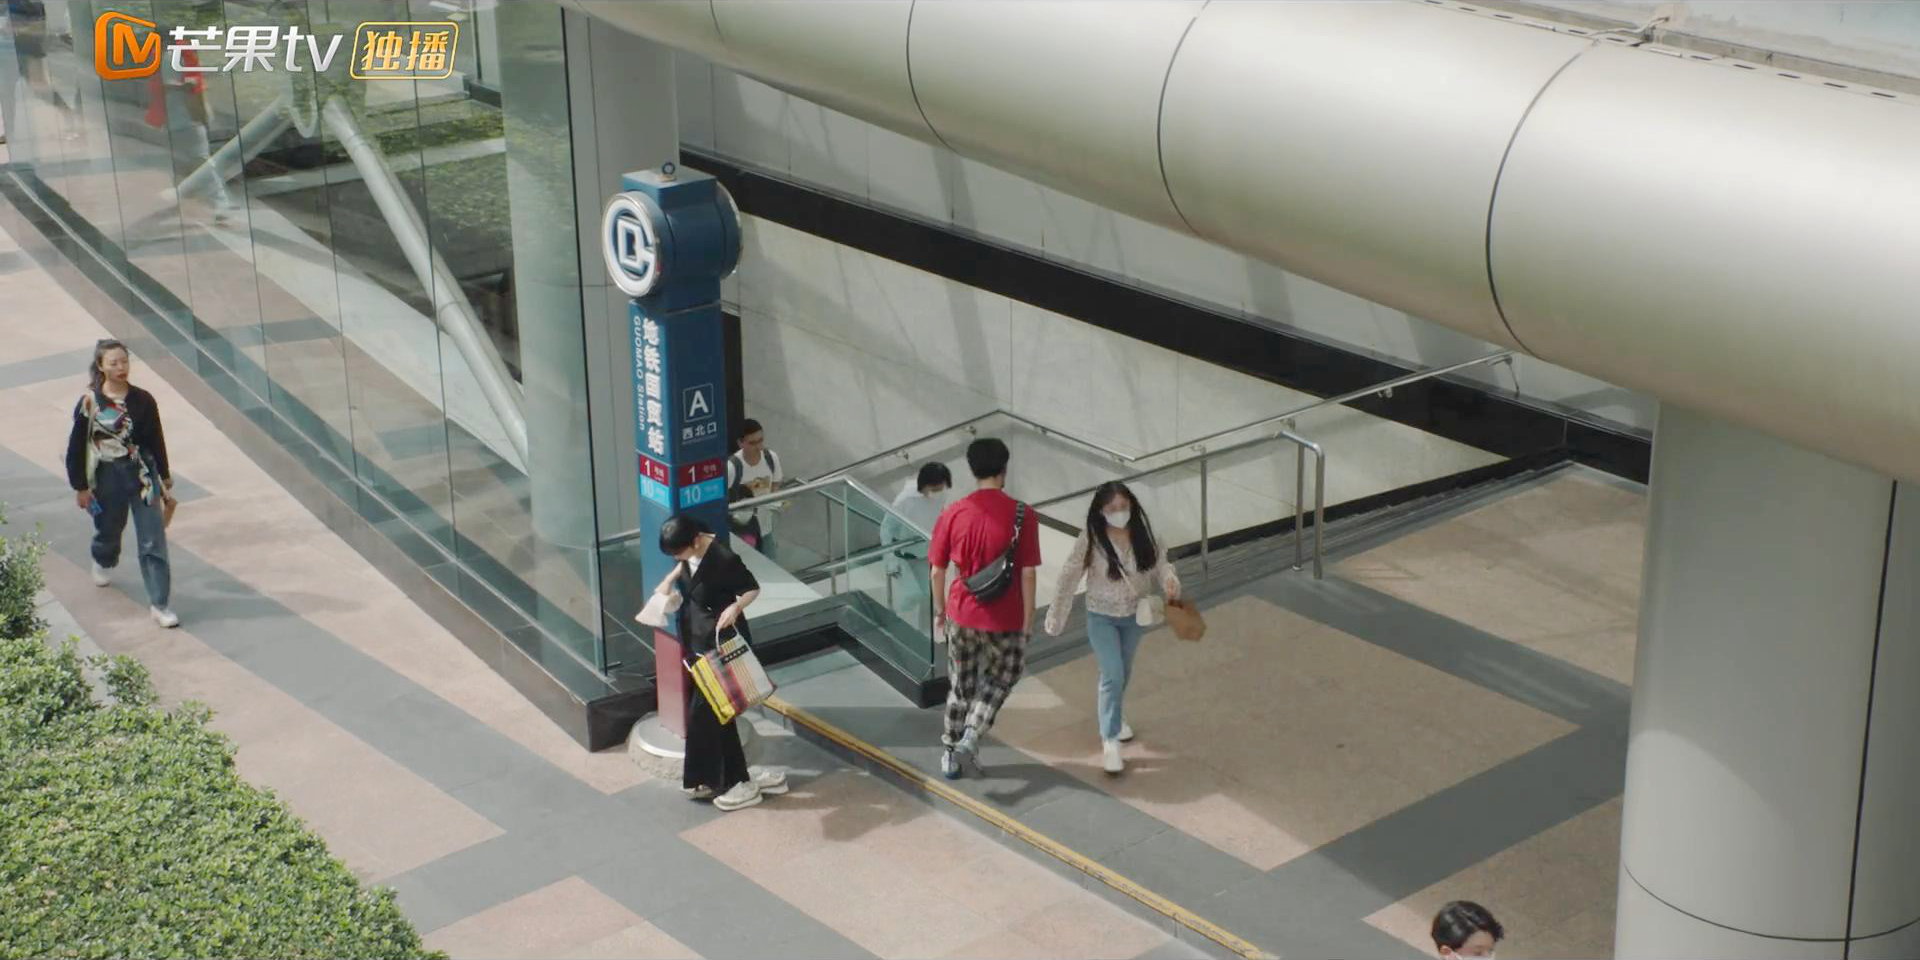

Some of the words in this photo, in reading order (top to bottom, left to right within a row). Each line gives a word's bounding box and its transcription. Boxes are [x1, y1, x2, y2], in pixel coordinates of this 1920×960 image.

[633, 315, 645, 379] GUOMAO
[642, 317, 665, 456] 地铁国贸站
[637, 383, 646, 431] Station
[689, 390, 709, 417] A
[682, 422, 717, 440] 西北口
[645, 459, 651, 476] 1
[688, 466, 696, 483] 1
[685, 485, 701, 504] 10
